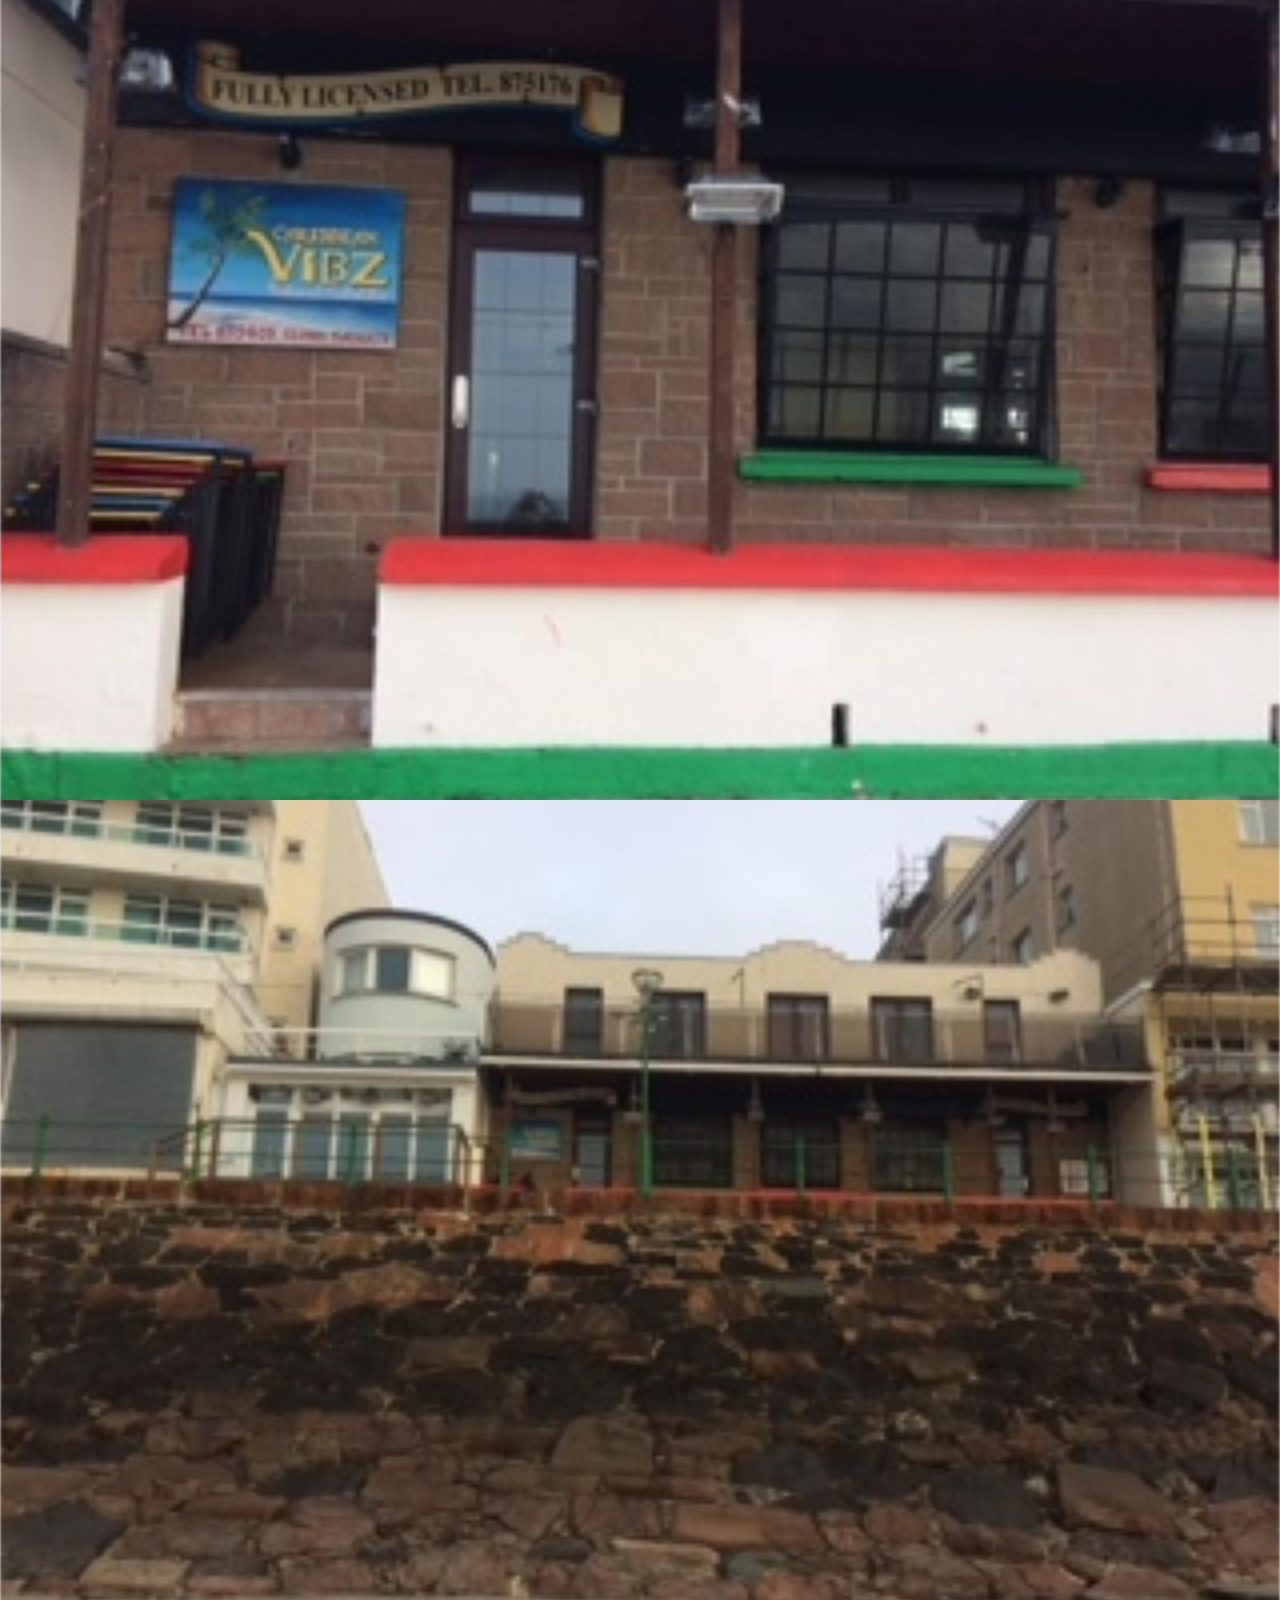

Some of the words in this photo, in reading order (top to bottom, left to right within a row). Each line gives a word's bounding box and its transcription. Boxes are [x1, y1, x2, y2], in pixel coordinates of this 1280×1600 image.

[211, 79, 293, 108] FULLY
[300, 77, 429, 108] LICENSED
[439, 71, 494, 97] TEL.
